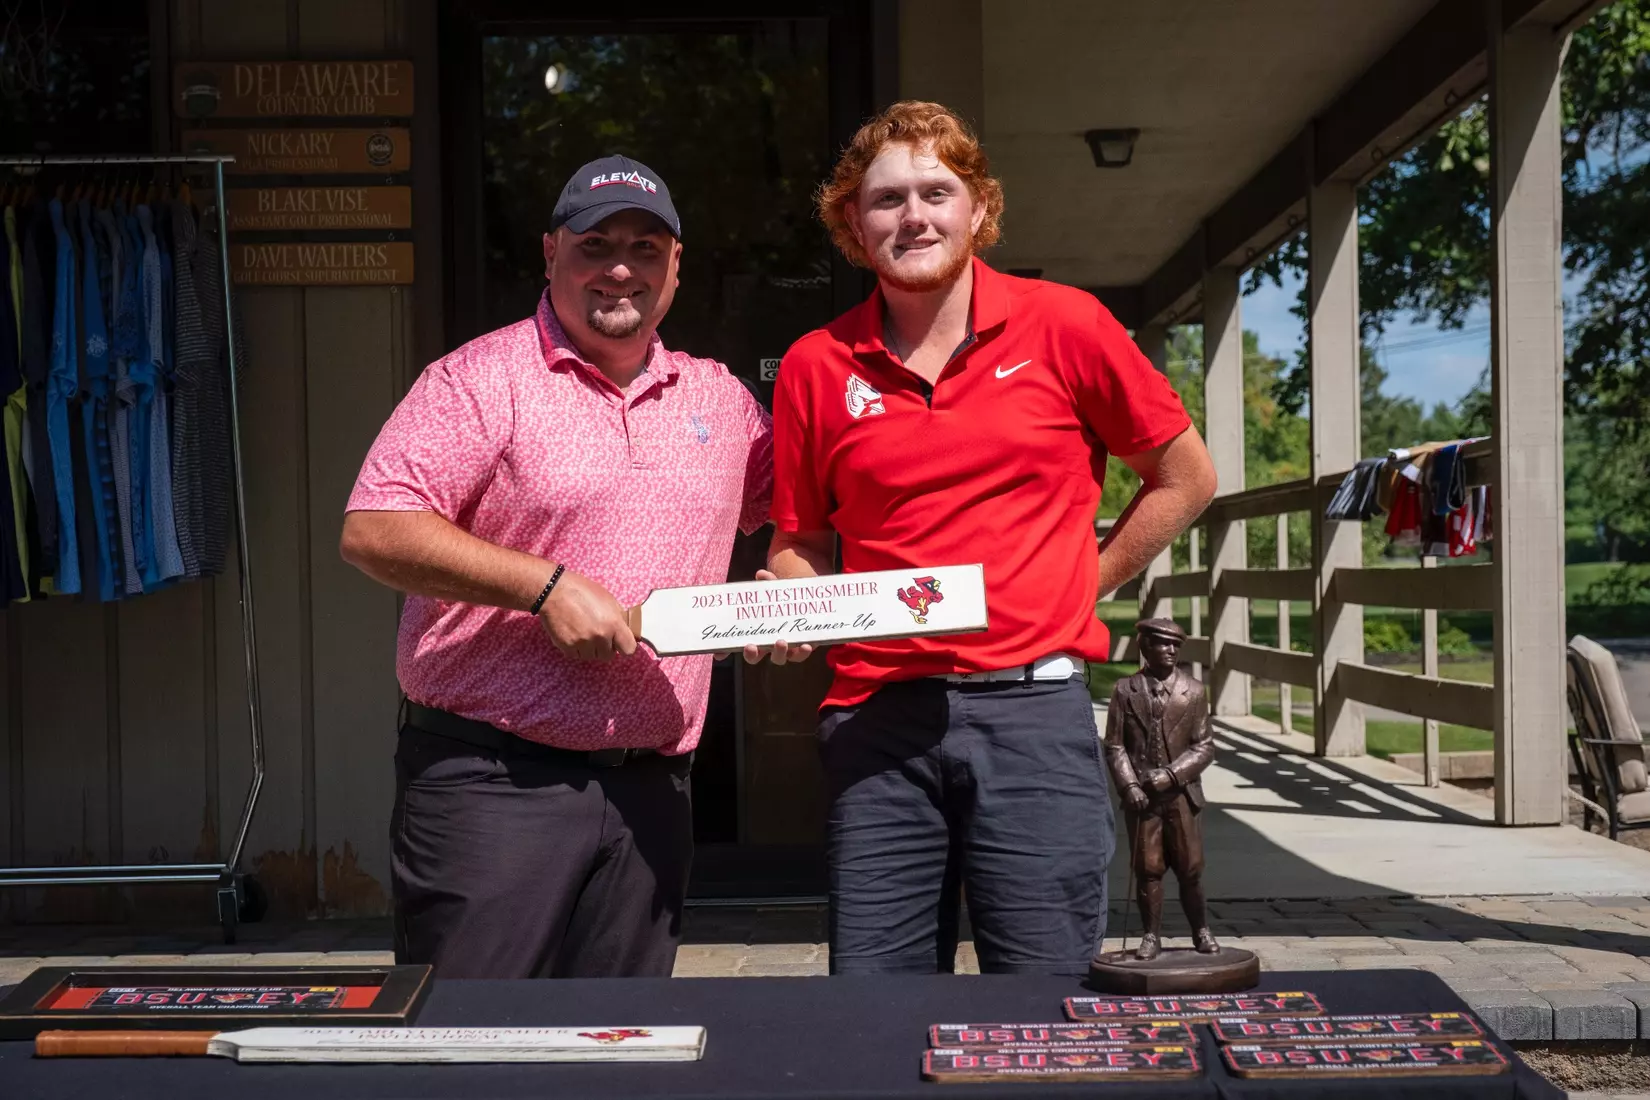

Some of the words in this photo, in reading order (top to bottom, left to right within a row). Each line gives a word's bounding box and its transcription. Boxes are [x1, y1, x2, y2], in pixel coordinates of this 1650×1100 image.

[234, 63, 400, 98] DELAWARE
[256, 96, 331, 115] COUNTRY
[334, 96, 376, 115] CLUB
[590, 170, 657, 192] ELEVATE
[257, 189, 321, 212] BLAKE
[325, 188, 369, 212] VISE
[233, 213, 288, 228] ASSISTANT
[289, 213, 315, 227] GOLF
[318, 212, 394, 227] PROFESSIONAL
[243, 246, 294, 268] DAVE
[297, 244, 388, 268] WALTERS
[233, 270, 259, 283] GOLF
[261, 270, 301, 283] COURSE
[304, 269, 399, 283] SUPERINTENDENT
[691, 593, 723, 609] 2023
[726, 591, 762, 606] EARL
[765, 581, 878, 603] YESTINGSMEIER
[735, 600, 837, 621] INVITATIONAL
[701, 621, 788, 640] Individual
[788, 613, 877, 636] Runner-Up
[114, 992, 207, 1005] BSU
[1092, 1000, 1181, 1014] BSU
[958, 1028, 1050, 1042] BSU
[1239, 1022, 1334, 1036] BSU
[952, 1054, 1046, 1068] BSU
[1254, 1050, 1352, 1065] BSU
